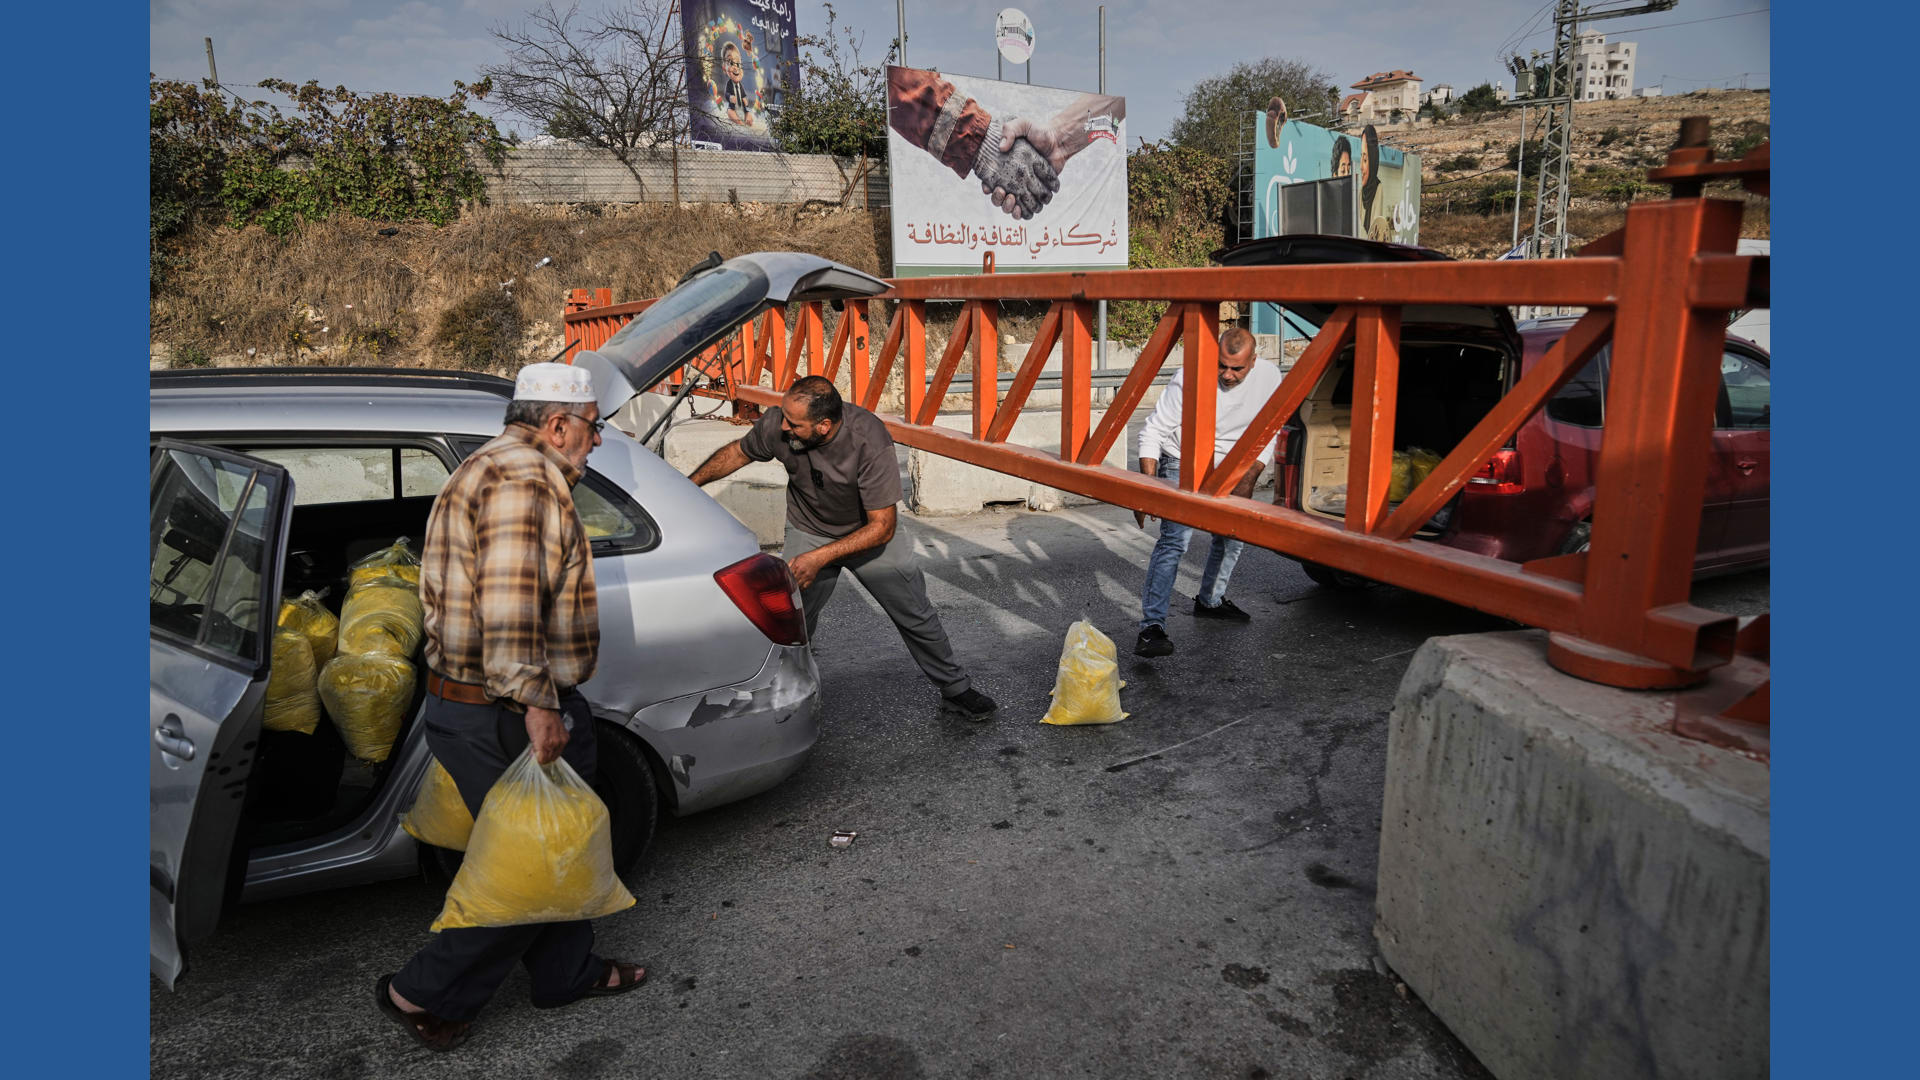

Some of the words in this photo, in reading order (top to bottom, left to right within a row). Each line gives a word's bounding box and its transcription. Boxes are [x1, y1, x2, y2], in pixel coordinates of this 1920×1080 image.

[907, 222, 978, 250] والنظافة
[979, 223, 1027, 246] الثقافة
[1029, 225, 1050, 260] في
